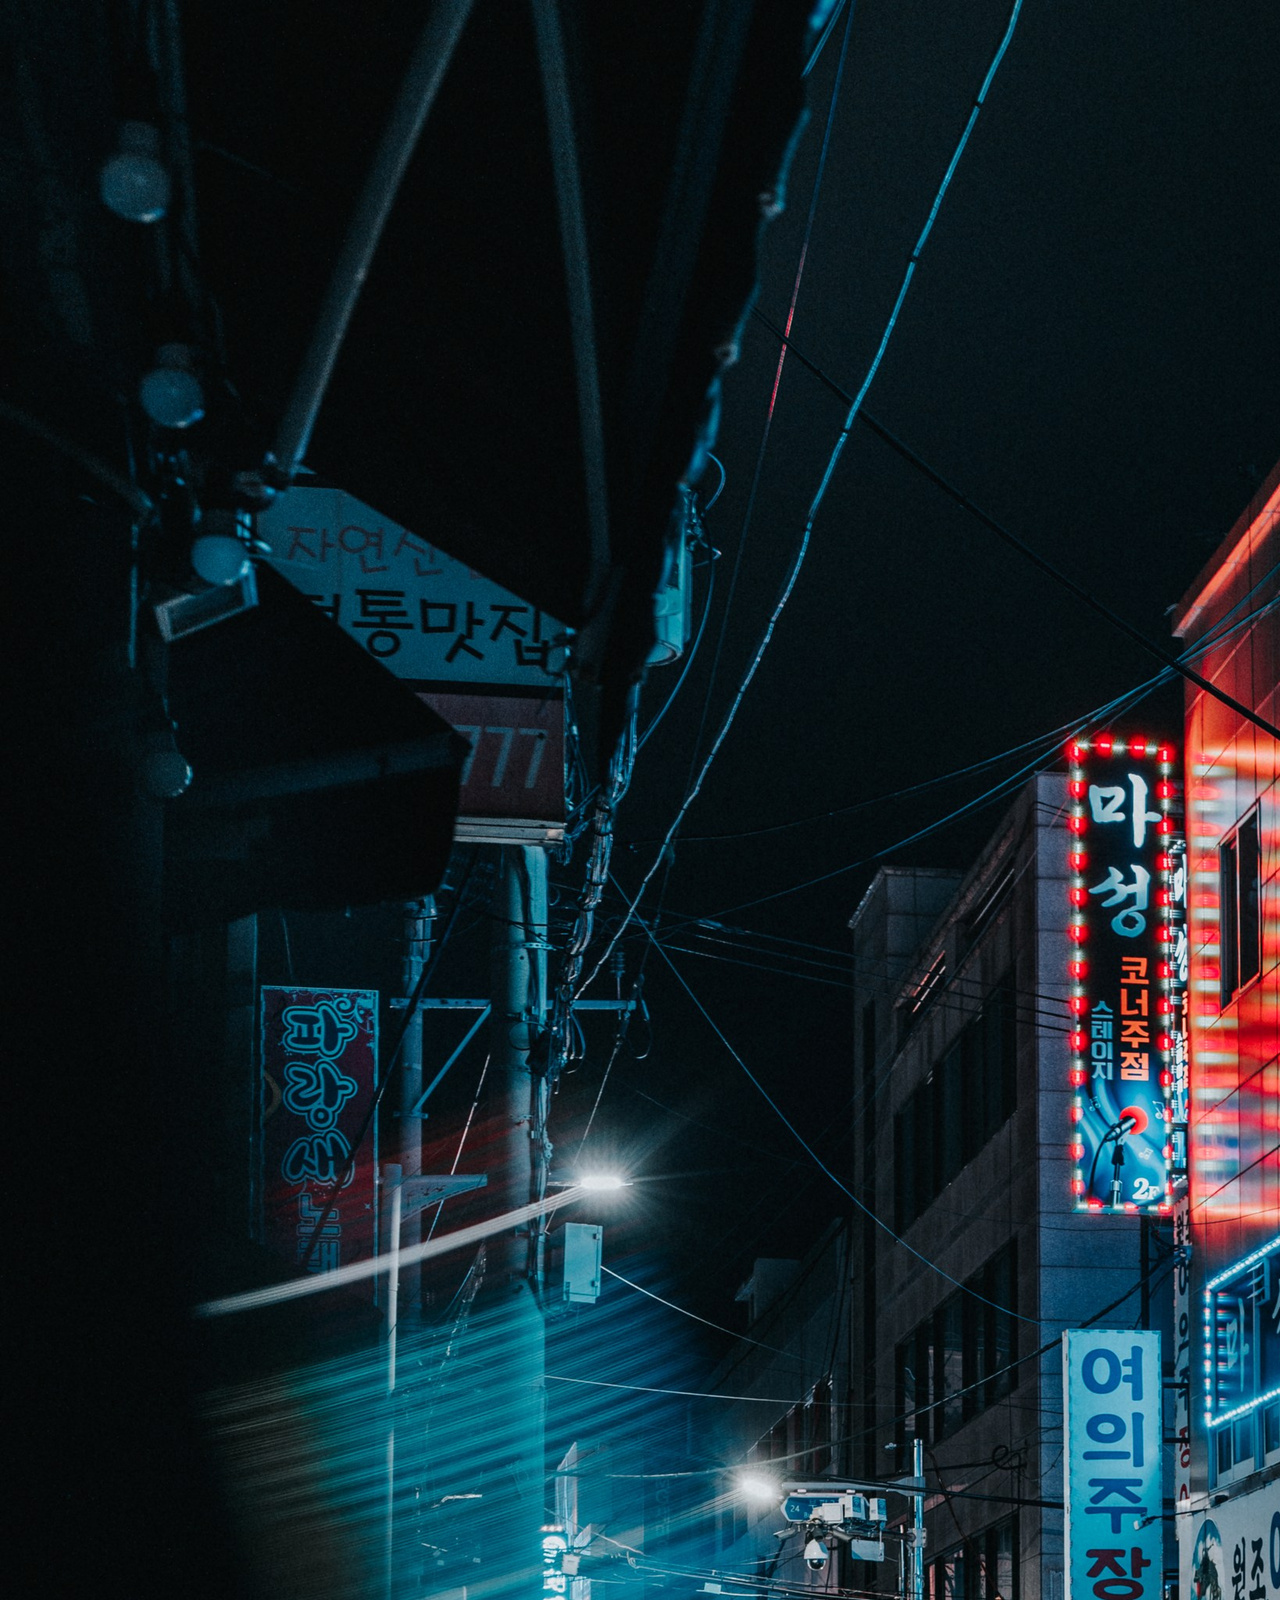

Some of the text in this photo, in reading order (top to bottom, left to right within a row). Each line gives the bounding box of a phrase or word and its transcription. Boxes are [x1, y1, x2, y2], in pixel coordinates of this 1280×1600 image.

[1089, 772, 1161, 938] 마성
[1091, 1000, 1114, 1081] 스테이지
[1120, 956, 1150, 1082] 코너주점
[1133, 1177, 1160, 1200] 2F
